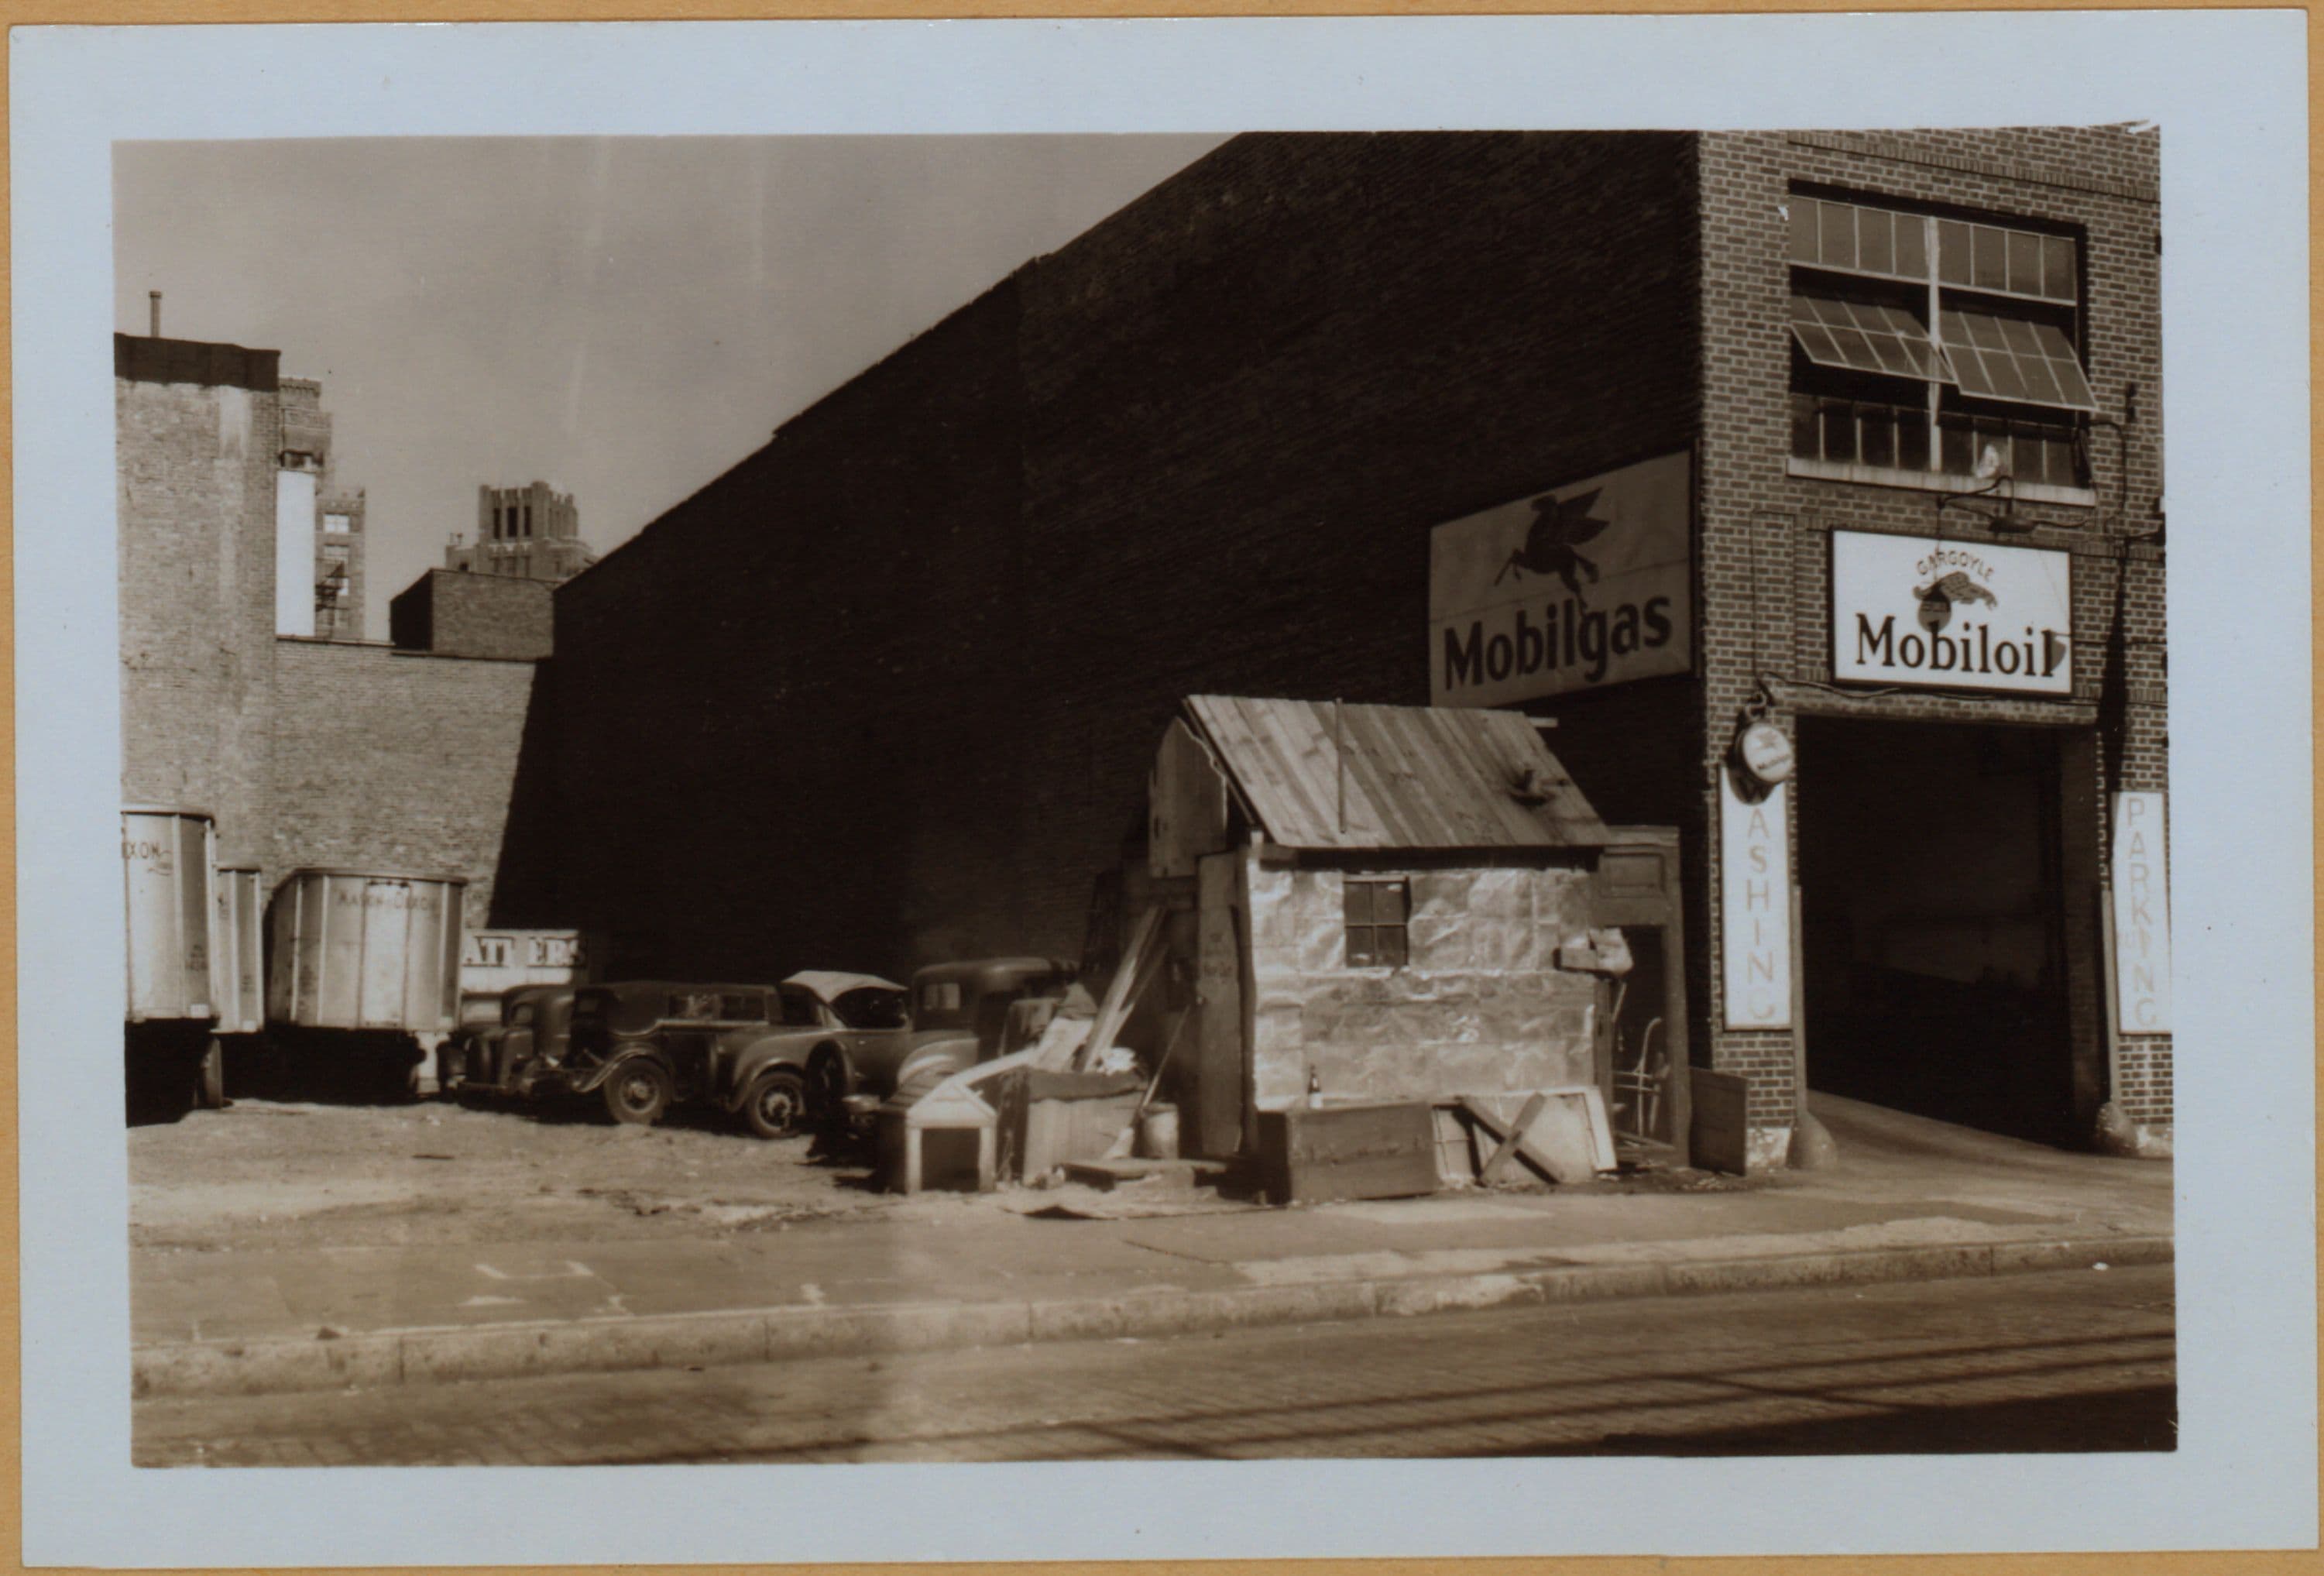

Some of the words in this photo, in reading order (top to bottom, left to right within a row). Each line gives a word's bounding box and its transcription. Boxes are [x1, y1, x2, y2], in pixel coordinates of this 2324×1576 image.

[1917, 551, 1995, 582] GARGOYLE
[1444, 595, 1672, 690] Mobilgas
[1855, 613, 2055, 678] Mobiloil
[2127, 798, 2158, 1027] PARKING
